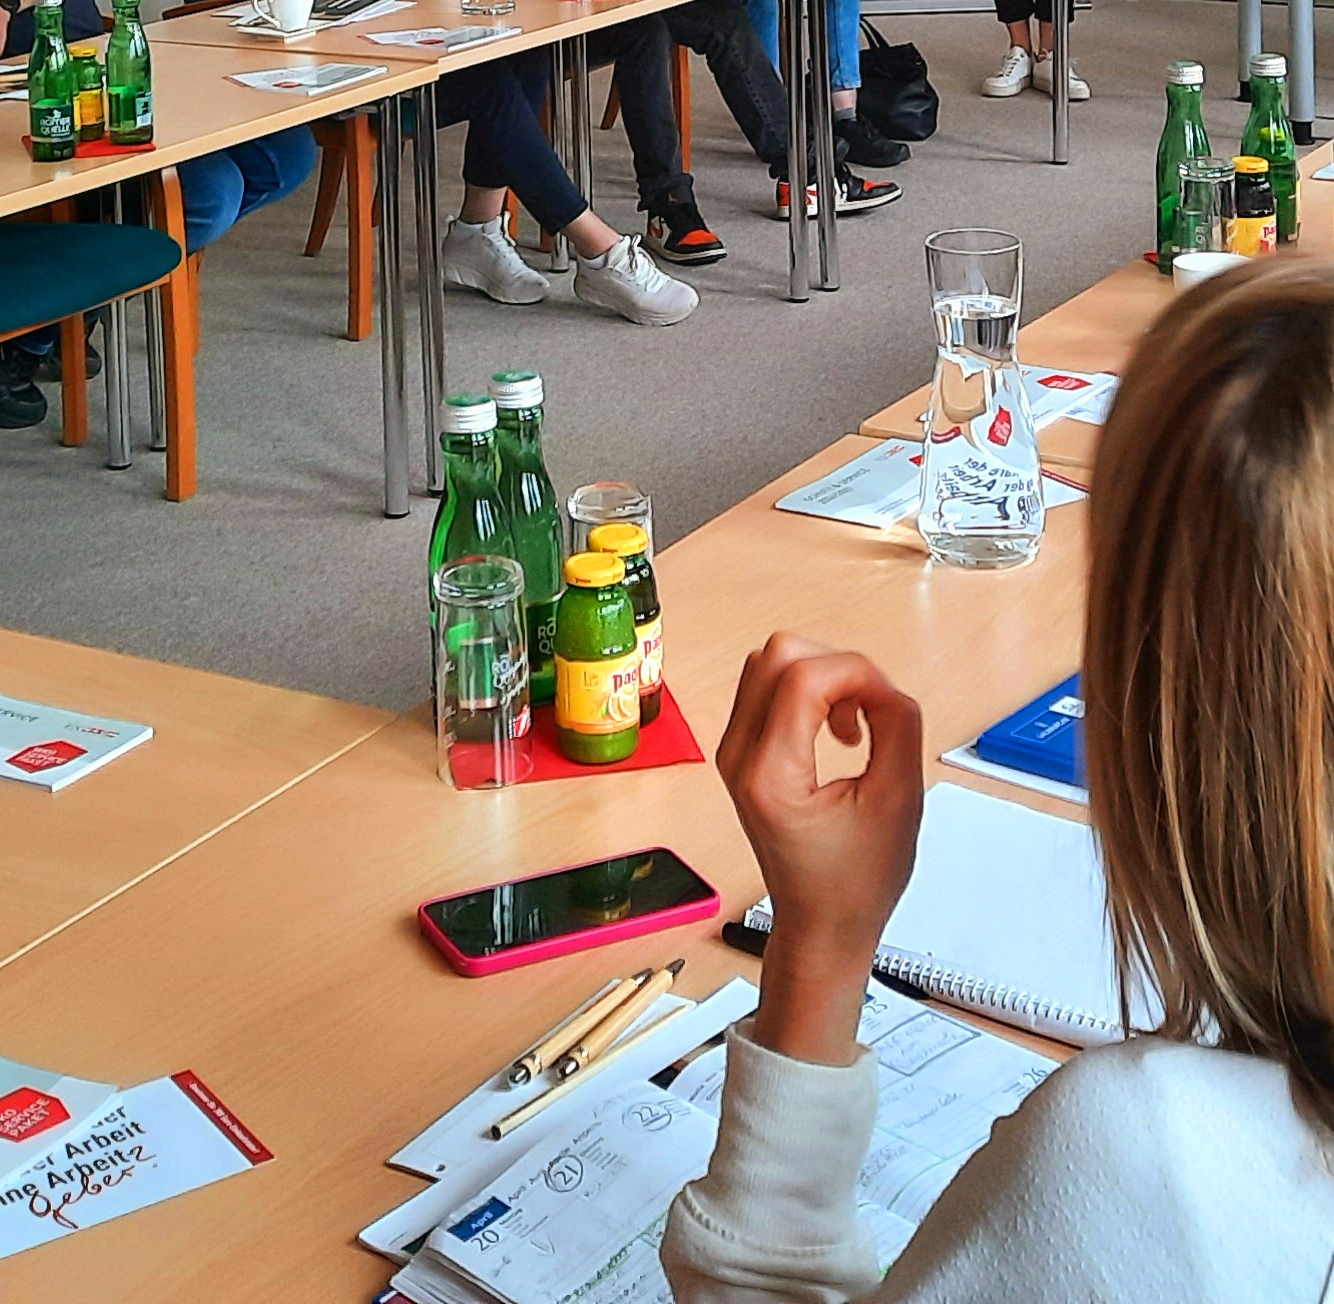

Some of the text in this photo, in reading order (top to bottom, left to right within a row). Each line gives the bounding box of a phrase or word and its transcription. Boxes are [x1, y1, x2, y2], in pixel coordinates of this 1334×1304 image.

[1023, 1066, 1048, 1087] 26
[8, 1106, 51, 1137] PAKET
[630, 1104, 659, 1124] 22
[64, 1119, 147, 1161] Arbeit
[46, 1146, 133, 1191] Arbeit
[553, 1164, 581, 1186] 21
[469, 1209, 494, 1232] April
[470, 1229, 500, 1253] 20
